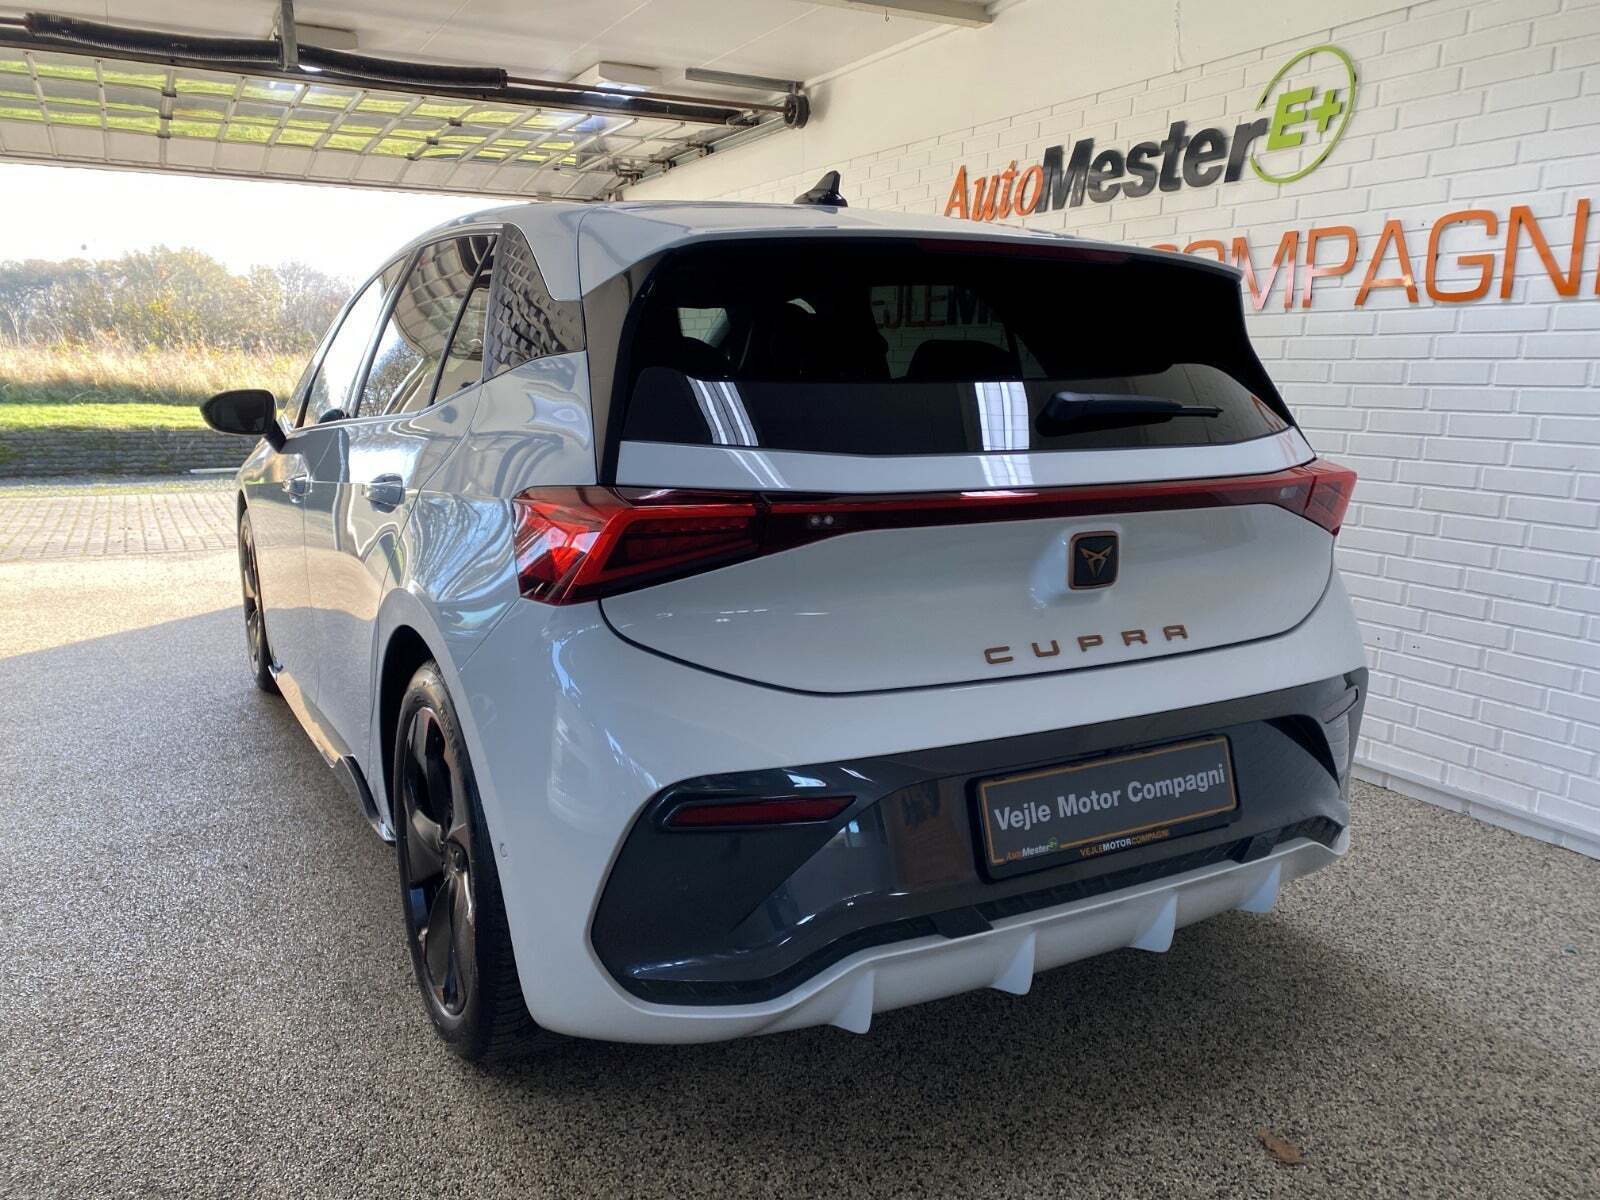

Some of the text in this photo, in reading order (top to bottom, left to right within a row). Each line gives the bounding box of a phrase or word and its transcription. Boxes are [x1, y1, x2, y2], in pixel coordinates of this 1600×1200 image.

[984, 624, 1189, 665] CUPRA
[994, 763, 1225, 831] Vejle Motor Compagni
